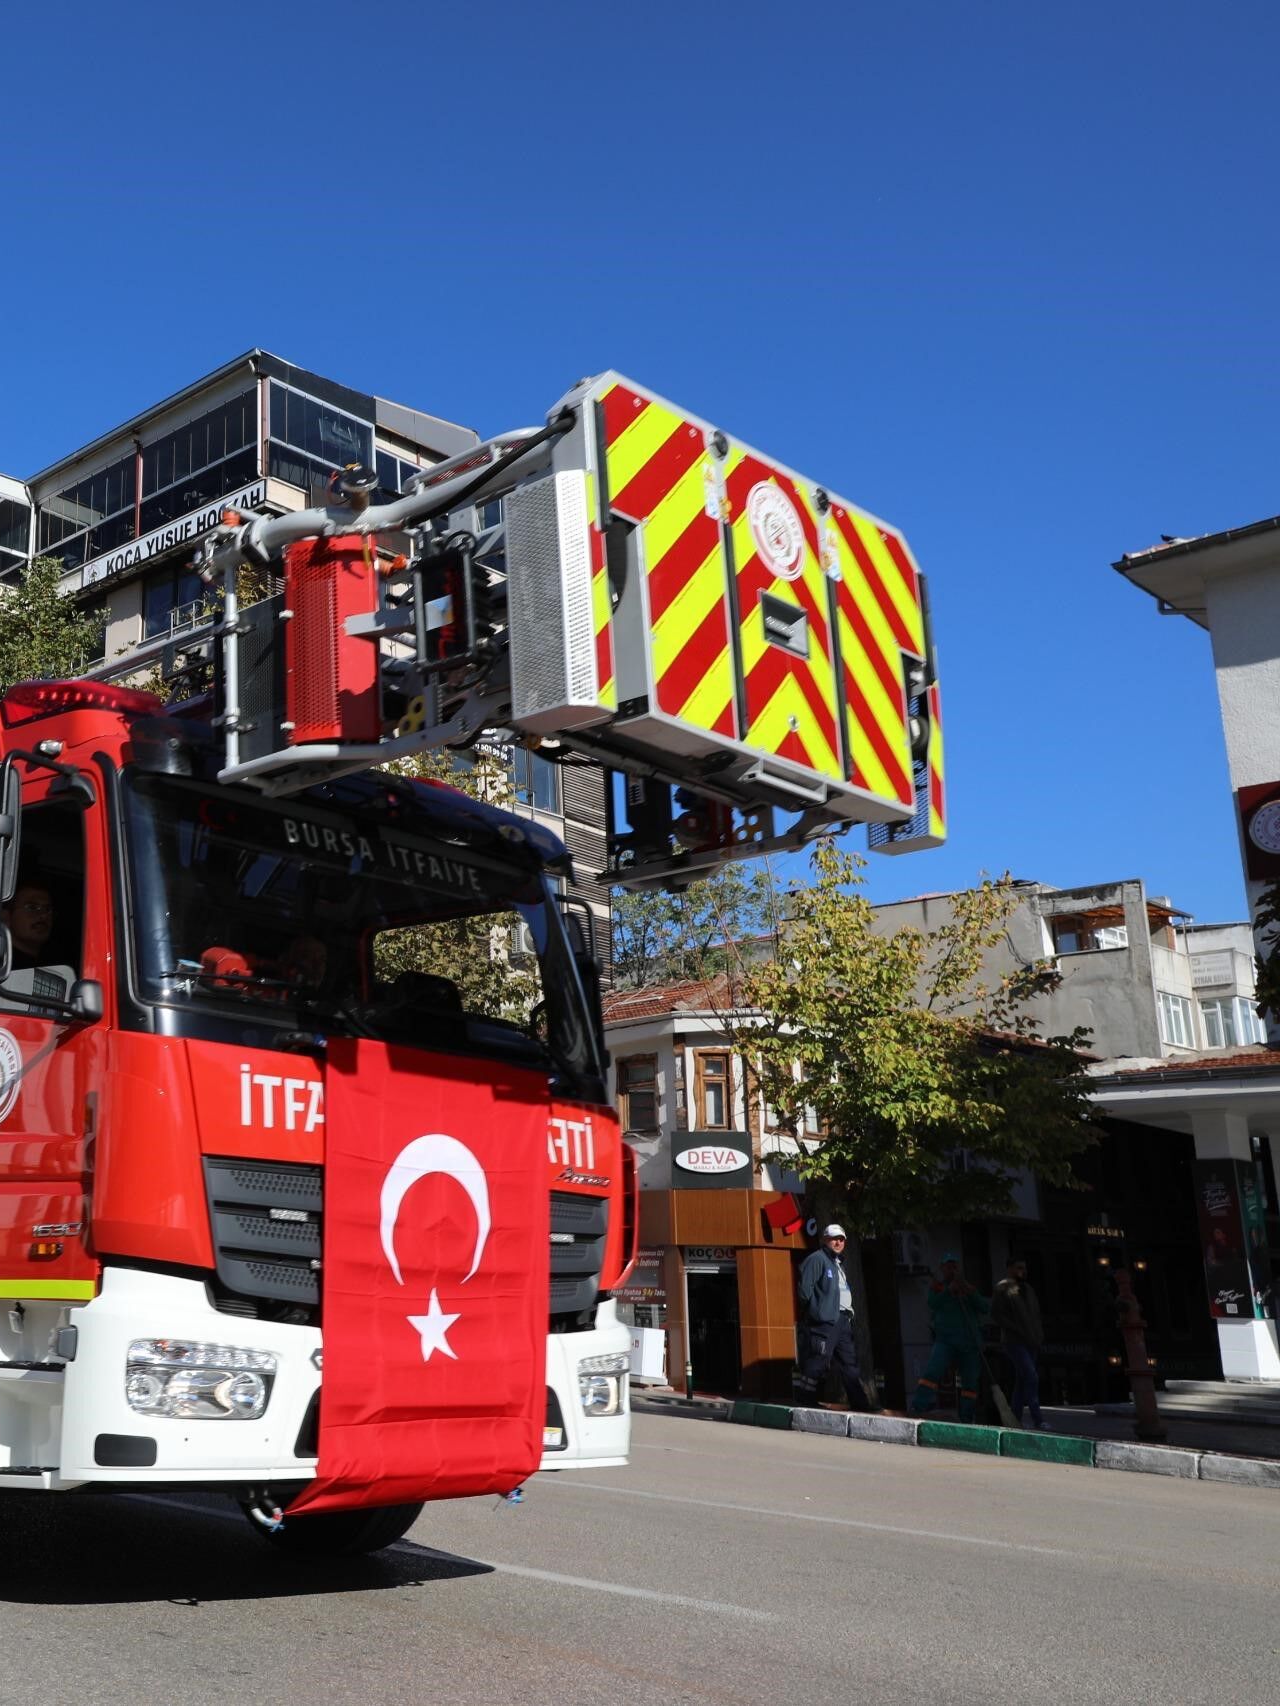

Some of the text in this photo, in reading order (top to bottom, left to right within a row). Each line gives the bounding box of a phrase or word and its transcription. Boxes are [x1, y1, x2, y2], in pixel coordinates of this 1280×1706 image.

[106, 546, 141, 576] KOCA
[146, 521, 193, 557] YUSUF
[284, 819, 481, 891] BURSA İTFAİYE
[688, 1151, 738, 1165] DEVA
[688, 1248, 736, 1260] KOÇAL
